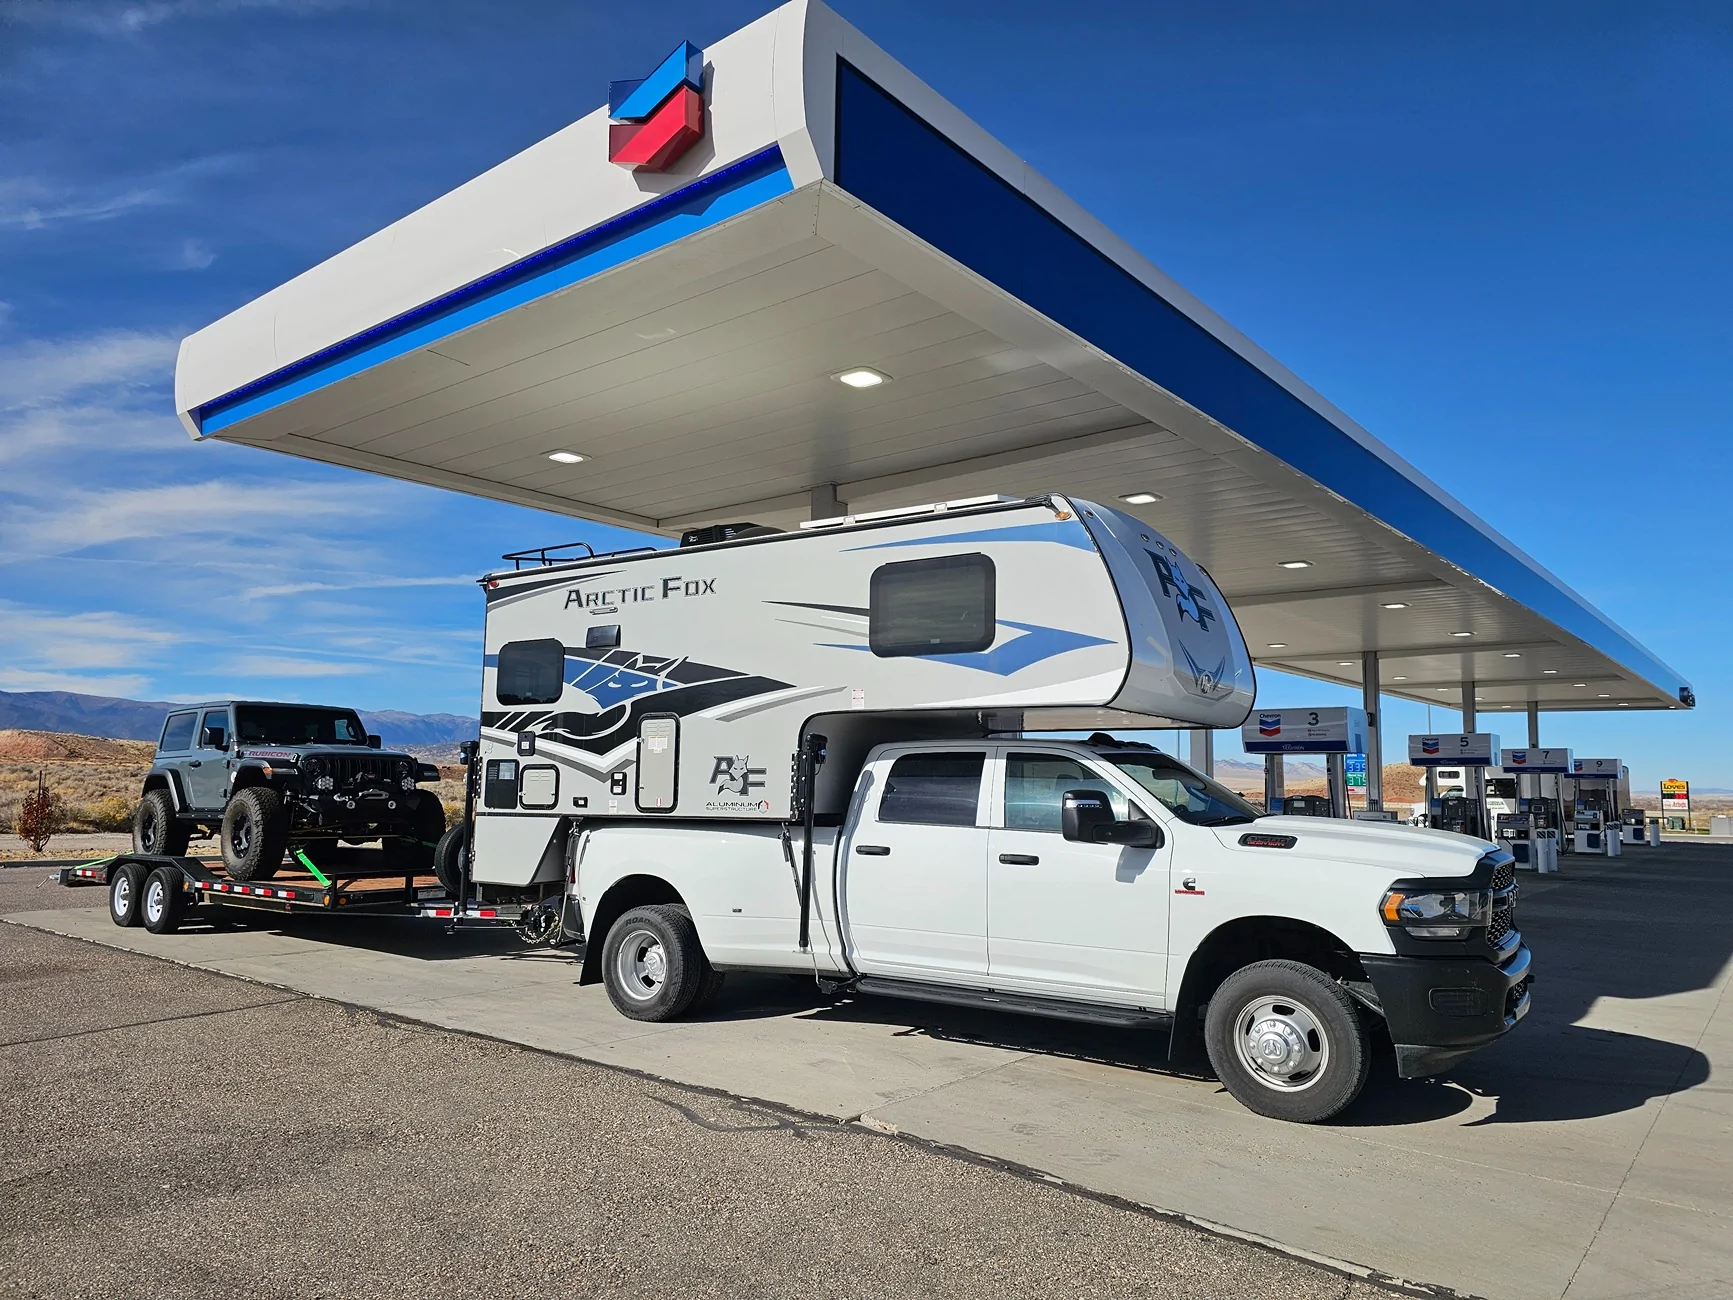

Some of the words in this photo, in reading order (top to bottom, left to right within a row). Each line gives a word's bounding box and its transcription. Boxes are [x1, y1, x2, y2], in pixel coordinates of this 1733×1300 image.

[563, 585, 656, 610] ARCTIC
[660, 576, 717, 599] FOX
[1307, 711, 1320, 726] 3
[1460, 736, 1469, 747] 5
[1542, 751, 1550, 759] 7
